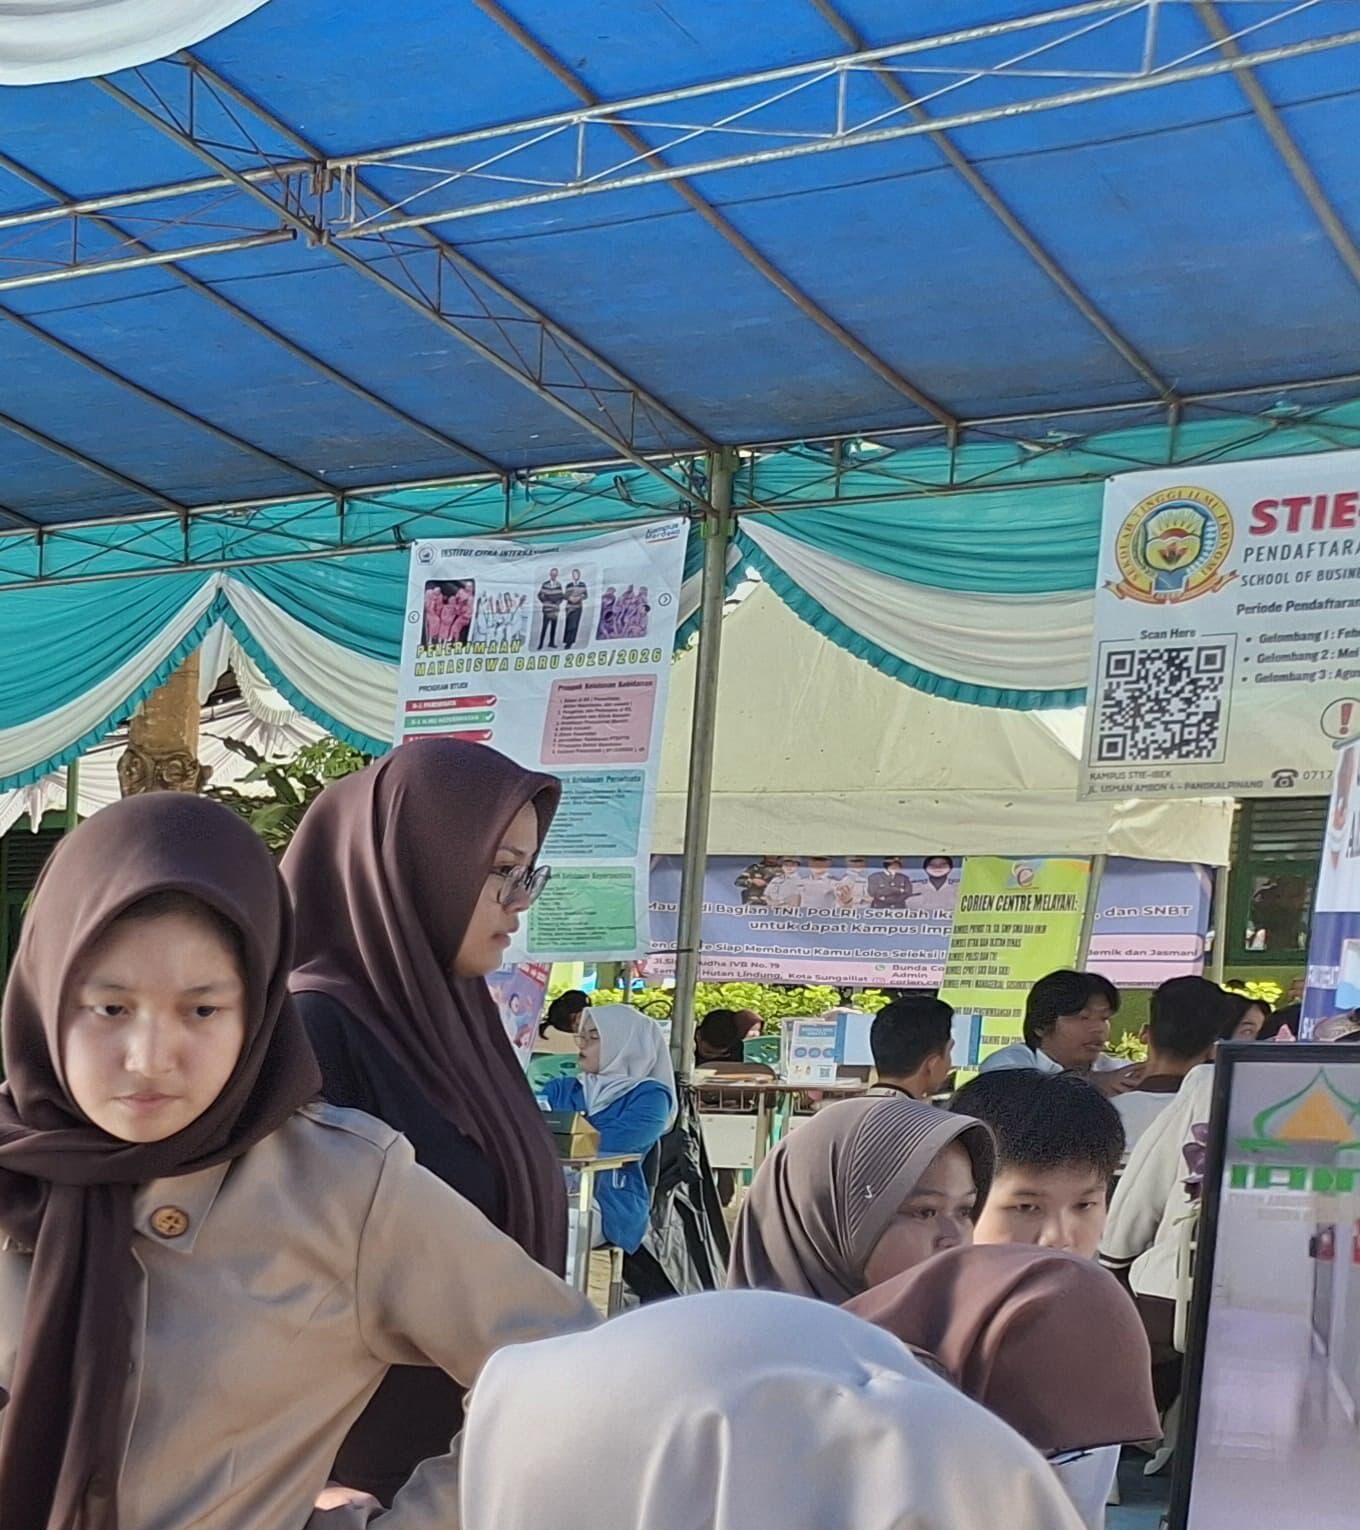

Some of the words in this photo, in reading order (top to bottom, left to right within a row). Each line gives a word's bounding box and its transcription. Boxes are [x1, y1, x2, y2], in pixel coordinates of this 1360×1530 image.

[1249, 492, 1360, 536] STIE
[1241, 572, 1290, 587] SCHOOL
[1295, 570, 1312, 583] OF
[1237, 603, 1282, 616] Periode
[1140, 629, 1167, 640] Scan
[416, 640, 522, 658] PENERIMAAN
[1320, 650, 1328, 660] 2
[414, 656, 510, 676] MAHASISWA
[514, 654, 560, 671] BARU
[564, 647, 662, 668] 2025/2026
[996, 894, 1032, 912] CENTRE
[716, 903, 768, 916] Bagian
[807, 908, 860, 920] POLRI,
[865, 908, 930, 919] Sekolah
[1105, 906, 1138, 917] dan
[1141, 905, 1192, 917] SNBT
[749, 920, 797, 931] untuk
[798, 921, 847, 934] dapat
[851, 923, 915, 935] Kampus
[714, 942, 742, 953] Siap
[744, 943, 811, 955] Membantu
[813, 946, 851, 957] Kamu
[855, 948, 888, 958] Lolos
[892, 949, 938, 960] Seleksi
[1124, 949, 1146, 957] dan
[891, 964, 925, 973] Bunda
[891, 971, 928, 979] Admin
[788, 972, 808, 980] Kota
